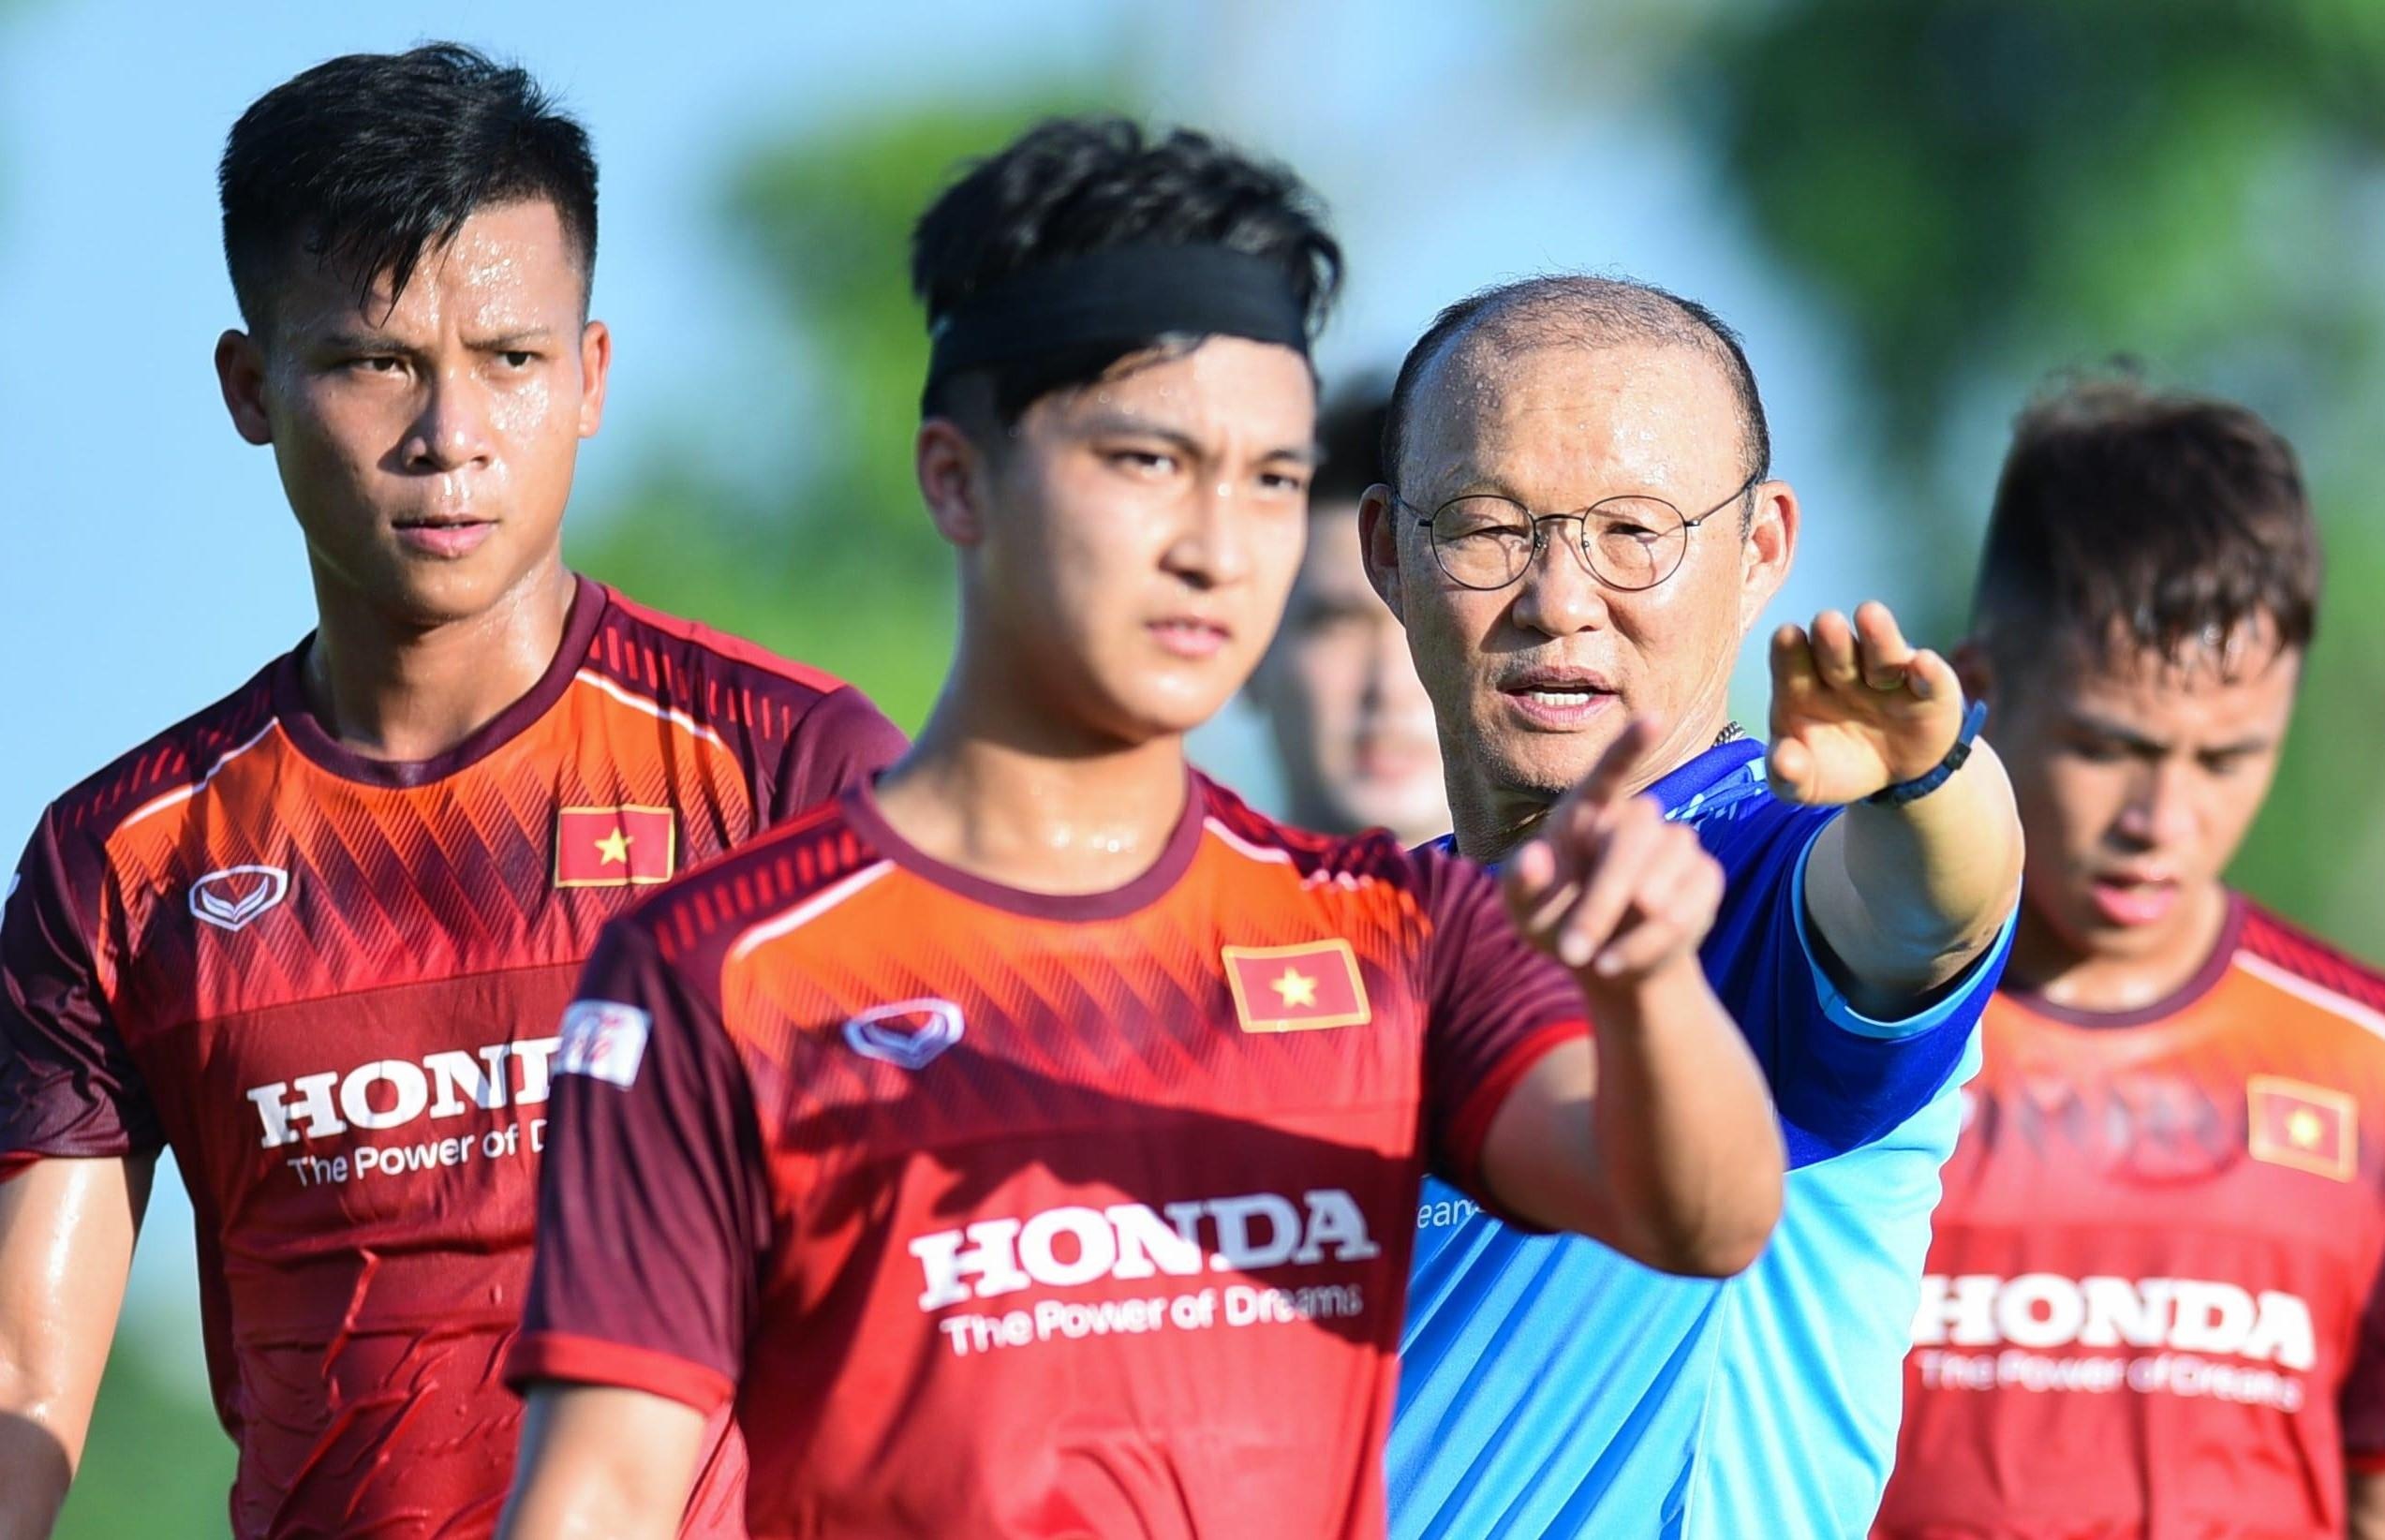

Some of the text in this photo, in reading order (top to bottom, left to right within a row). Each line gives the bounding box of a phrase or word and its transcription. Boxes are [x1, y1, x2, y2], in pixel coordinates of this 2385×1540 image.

[287, 1158, 348, 1186] The
[354, 1133, 474, 1179] Power
[481, 1126, 519, 1158] of
[910, 1189, 1379, 1312] HONDA
[940, 1281, 1364, 1356] The Power of Dreams
[1912, 1273, 2318, 1371] HONDA
